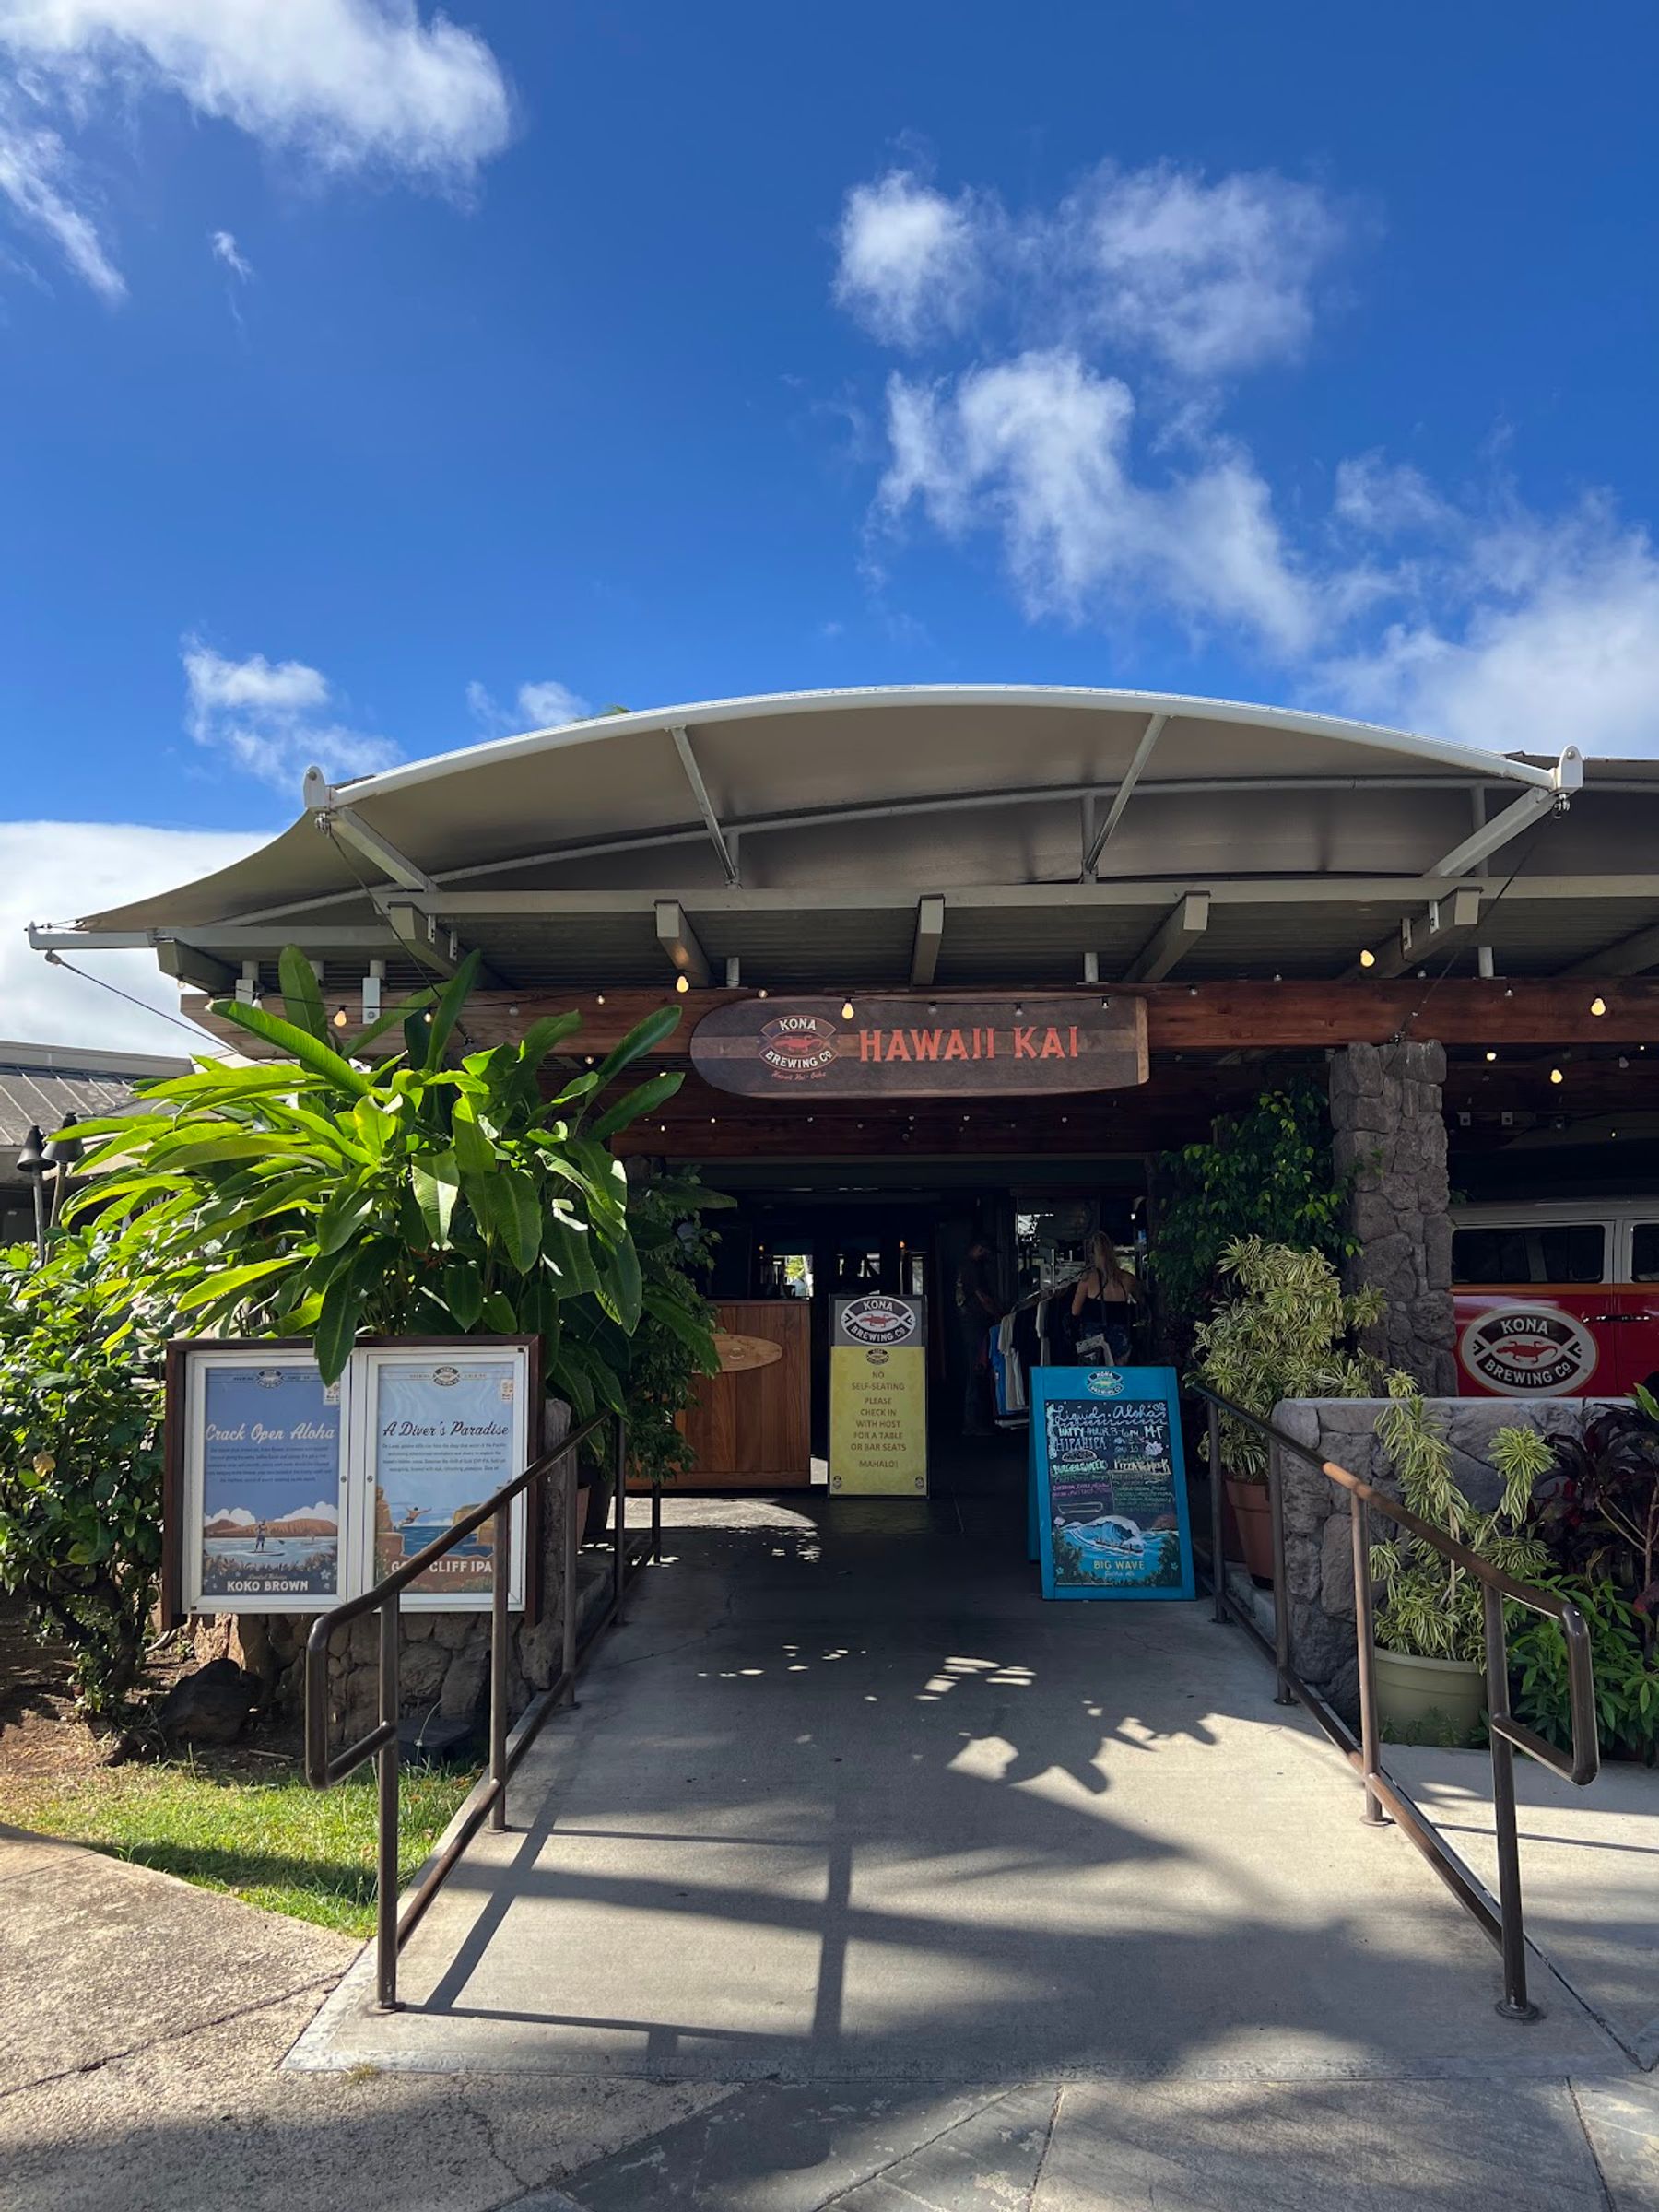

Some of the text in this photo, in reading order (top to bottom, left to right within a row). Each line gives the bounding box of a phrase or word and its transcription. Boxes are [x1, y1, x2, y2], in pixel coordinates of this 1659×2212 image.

[779, 1018, 817, 1031] KONA
[859, 1026, 1079, 1063] HAWAII KAI
[765, 1050, 818, 1069] BREWING
[863, 1300, 894, 1312] KONA
[850, 1324, 894, 1342] BREWING
[1500, 1318, 1549, 1335] KONA
[1484, 1359, 1553, 1385] BREWING
[852, 1382, 905, 1391] SELF-SEATING
[860, 1408, 897, 1417] CHECK IN
[206, 1422, 335, 1444] Crack Open Aloha
[382, 1420, 509, 1436] A Diver's Paradise
[853, 1431, 903, 1440] FOR A TABLE
[850, 1443, 907, 1452] OR BAR SEATS
[429, 1560, 493, 1573] CLIFF IPA
[1093, 1559, 1145, 1570] BIG WAVE
[227, 1580, 309, 1592] KOKO BROWN
